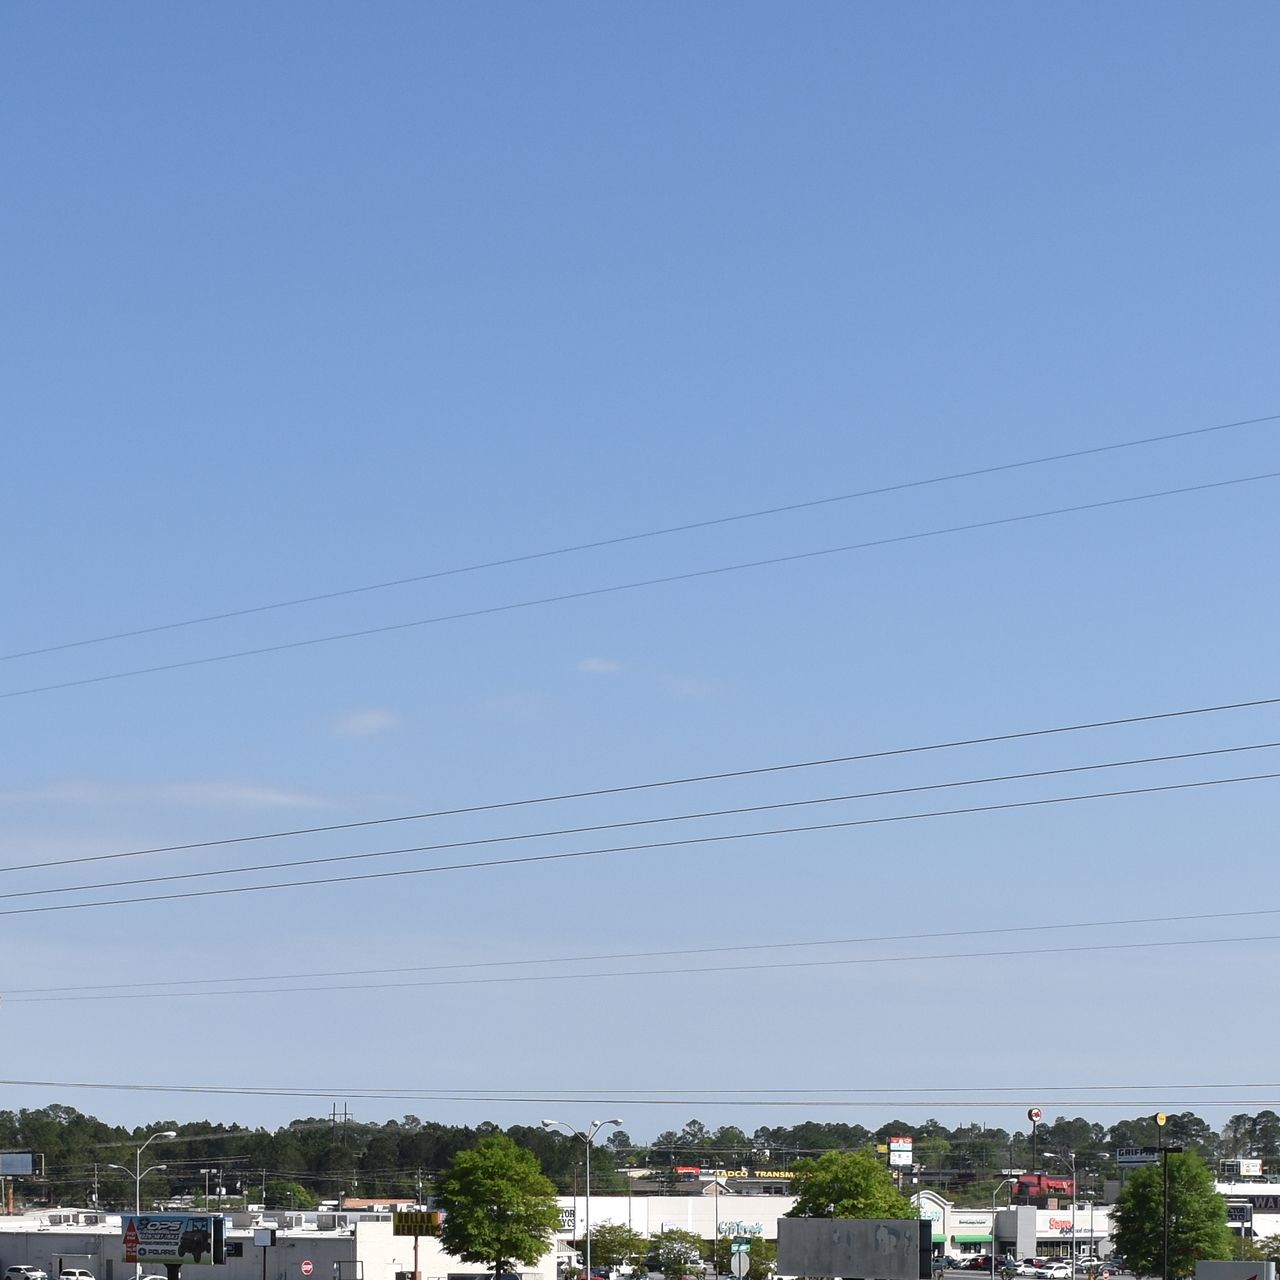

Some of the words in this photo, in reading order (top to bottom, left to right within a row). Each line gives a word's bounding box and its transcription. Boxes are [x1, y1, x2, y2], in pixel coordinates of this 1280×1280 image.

[397, 1212, 433, 1223] DOLLAR
[146, 1221, 182, 1231] OPS
[395, 1223, 439, 1235] GENERAL
